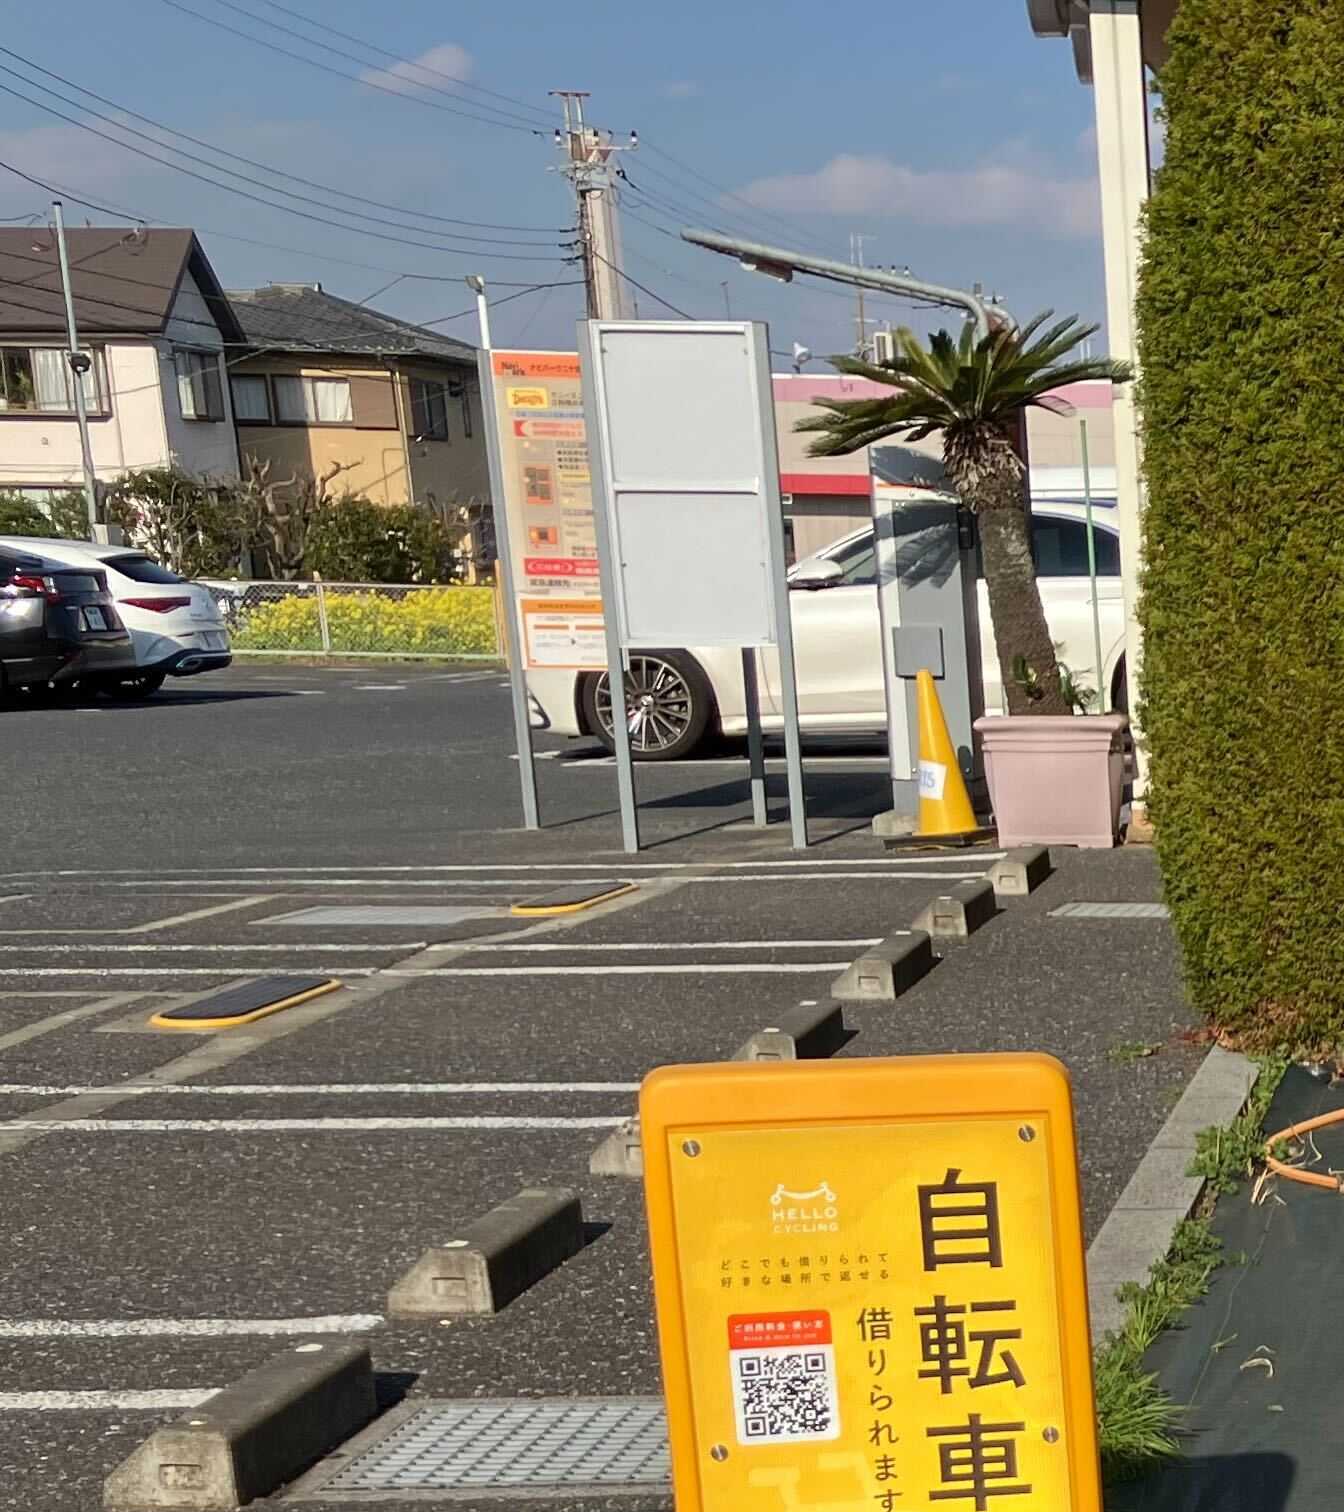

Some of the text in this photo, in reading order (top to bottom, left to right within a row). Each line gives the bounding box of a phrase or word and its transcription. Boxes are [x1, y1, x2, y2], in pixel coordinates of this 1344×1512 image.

[772, 1206, 838, 1222] HELLO
[773, 1222, 839, 1233] CYCLING
[913, 1168, 1032, 1512] 自転車
